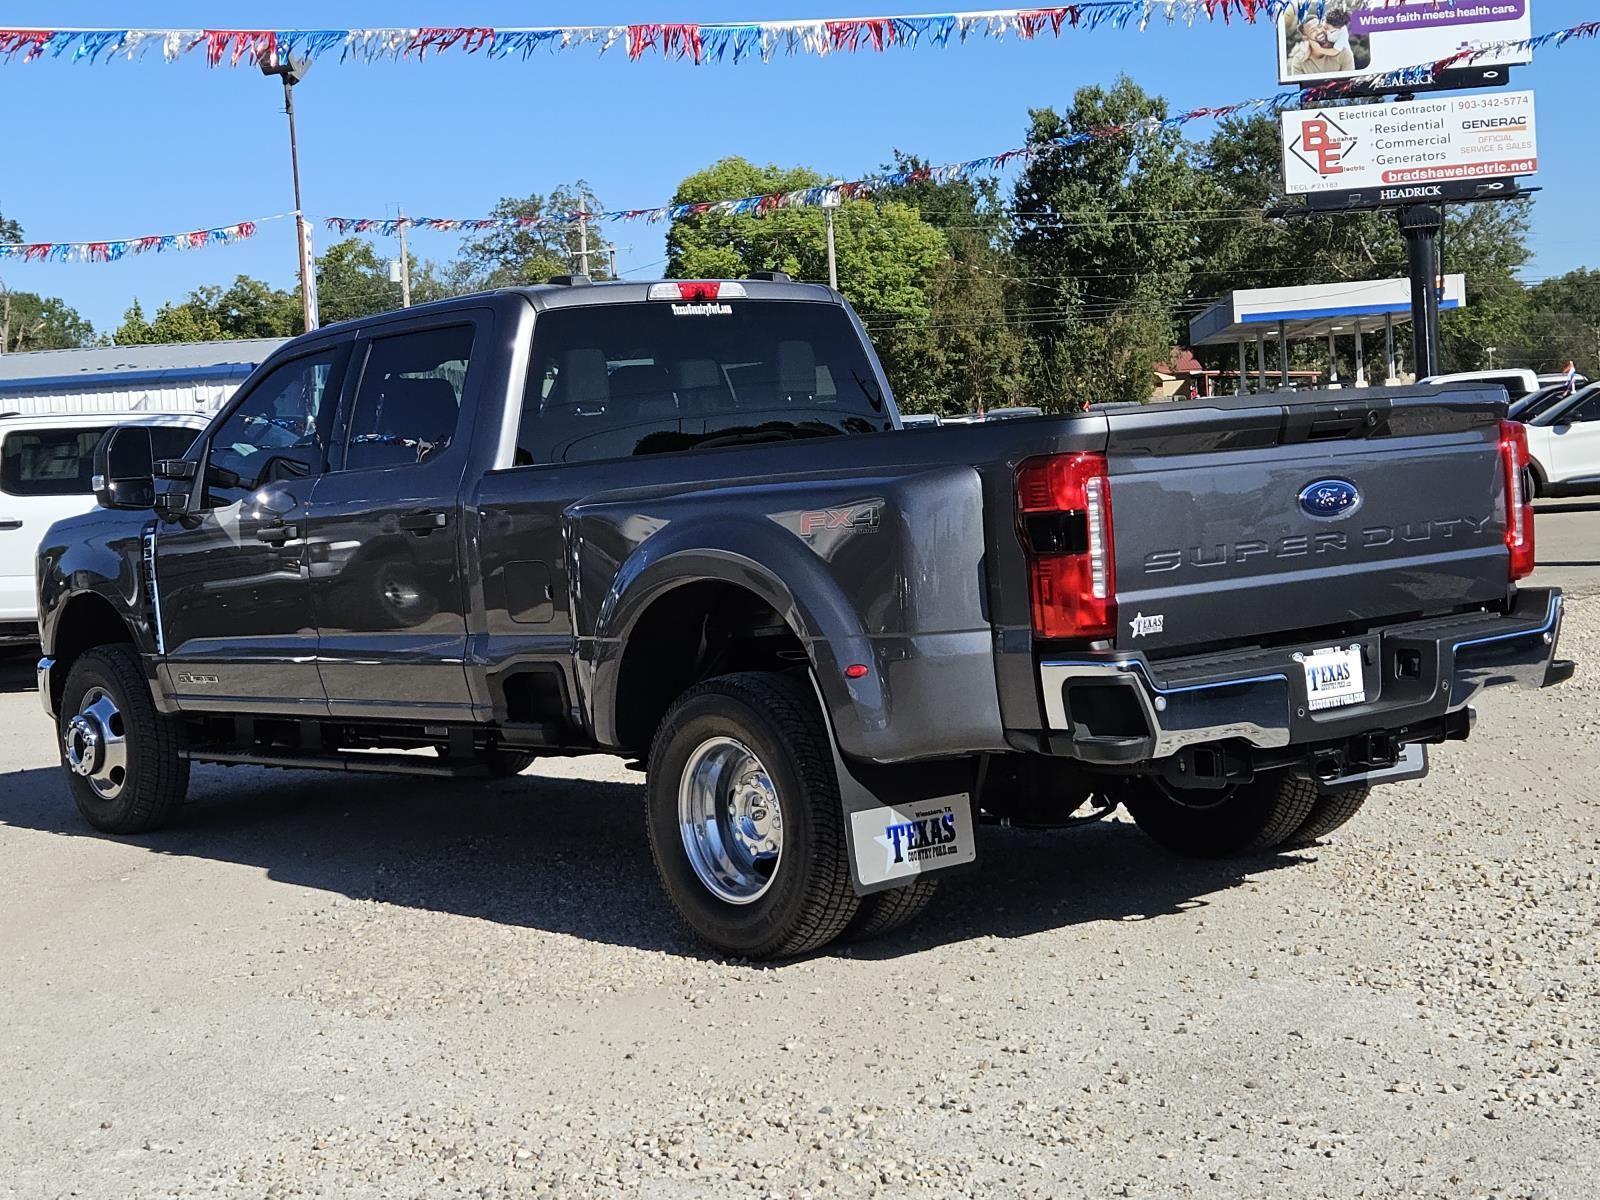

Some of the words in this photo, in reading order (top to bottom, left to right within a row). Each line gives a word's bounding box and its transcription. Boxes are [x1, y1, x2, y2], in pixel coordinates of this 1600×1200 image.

[1359, 15, 1395, 26] Where
[1396, 12, 1421, 23] faith
[1422, 10, 1455, 20] meets
[1456, 7, 1491, 18] health
[1491, 4, 1518, 14] care.
[1338, 108, 1388, 121] Electrical
[1390, 103, 1447, 116] Contractor
[1458, 96, 1529, 110] 903-342-5774
[1374, 117, 1444, 135] Residential
[1461, 116, 1527, 130] GENERAC
[1375, 132, 1451, 150] Commercial
[1460, 144, 1495, 154] SERVICE
[1497, 143, 1504, 151] &
[1505, 141, 1532, 150] SALES
[1478, 134, 1513, 144] OFFICIAL
[1376, 150, 1447, 165] Generators
[1388, 160, 1534, 182] bradshawelectric.net
[1380, 185, 1442, 200] HEADRICK
[800, 506, 881, 538] FX4
[1143, 530, 1348, 574] SUPER
[1361, 514, 1491, 548] DUTY
[1135, 616, 1163, 633] TEXAS
[1307, 662, 1351, 692] TEXAS
[885, 813, 957, 864] TEXAS
[907, 847, 932, 862] COUNTRY
